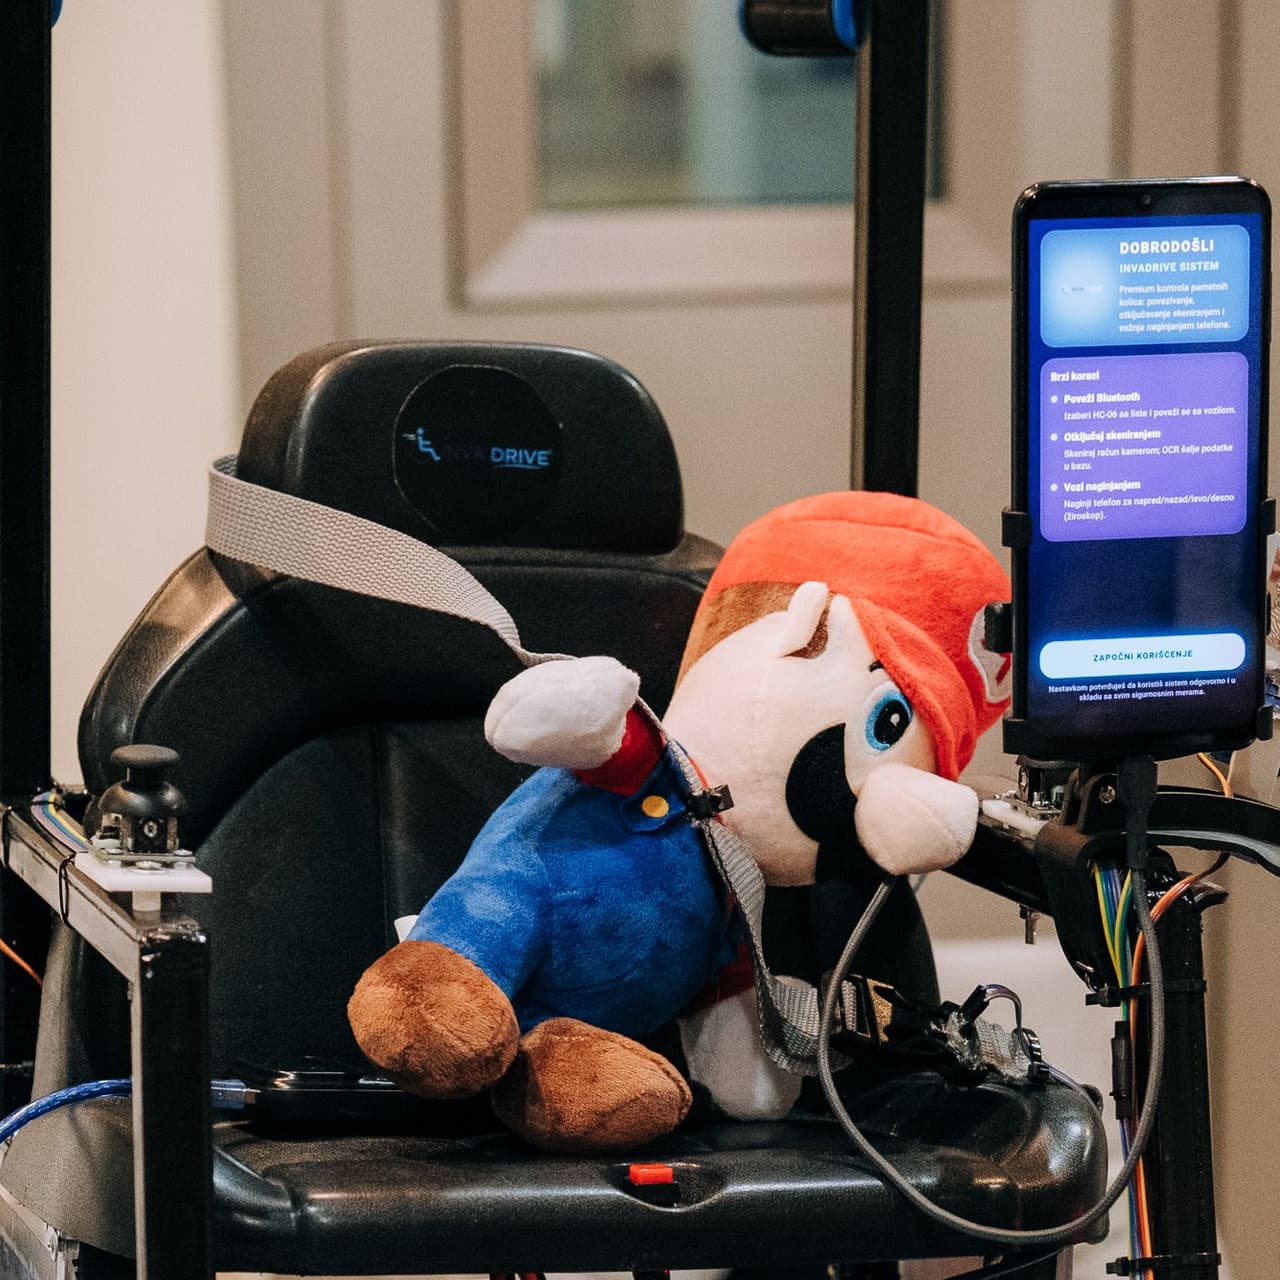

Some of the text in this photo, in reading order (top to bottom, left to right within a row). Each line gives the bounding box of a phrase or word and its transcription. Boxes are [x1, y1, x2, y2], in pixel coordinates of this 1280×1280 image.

[1120, 237, 1214, 254] DOBRODOŠLI
[1120, 261, 1219, 273] INVADRIVE SISTEM
[1120, 285, 1155, 294] Premium
[1157, 283, 1189, 293] kontrola
[1050, 371, 1100, 382] Brzi koraci
[1064, 392, 1140, 405] Poveži Bluetooth
[1093, 410, 1117, 419] HC-06
[1064, 429, 1161, 443] Otključaj skeniranjem
[490, 447, 552, 466] DRIVE
[1064, 449, 1096, 459] Skeniraj
[1162, 445, 1180, 454] OCR
[1064, 481, 1141, 493] Vozi naginjanjem
[1093, 649, 1193, 662] ZAPOČNI KORIŠĆENJE
[1048, 684, 1088, 693] Nastavkom
